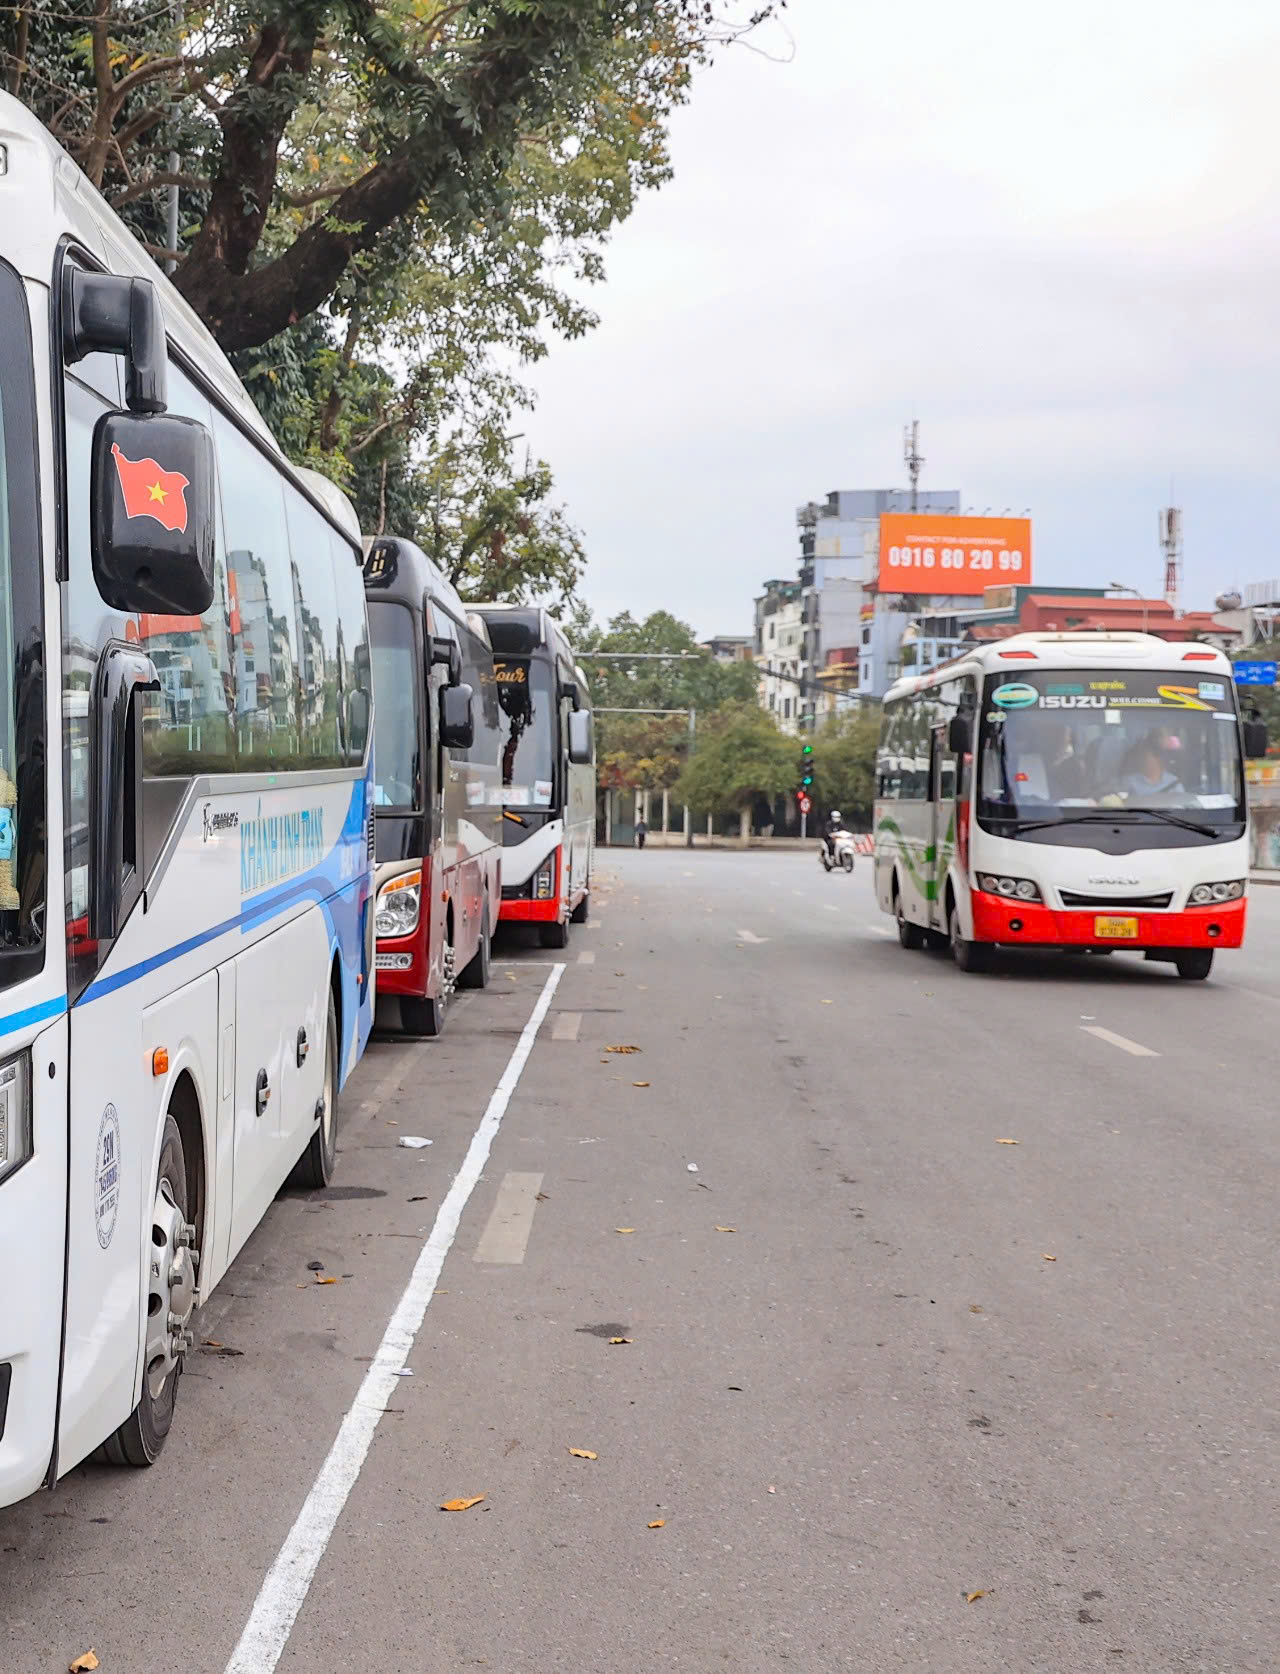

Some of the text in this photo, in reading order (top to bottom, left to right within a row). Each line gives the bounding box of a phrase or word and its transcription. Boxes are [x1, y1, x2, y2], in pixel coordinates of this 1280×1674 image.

[888, 546, 1023, 571] 0916 80 20 99
[1039, 695, 1107, 709] ISUZU
